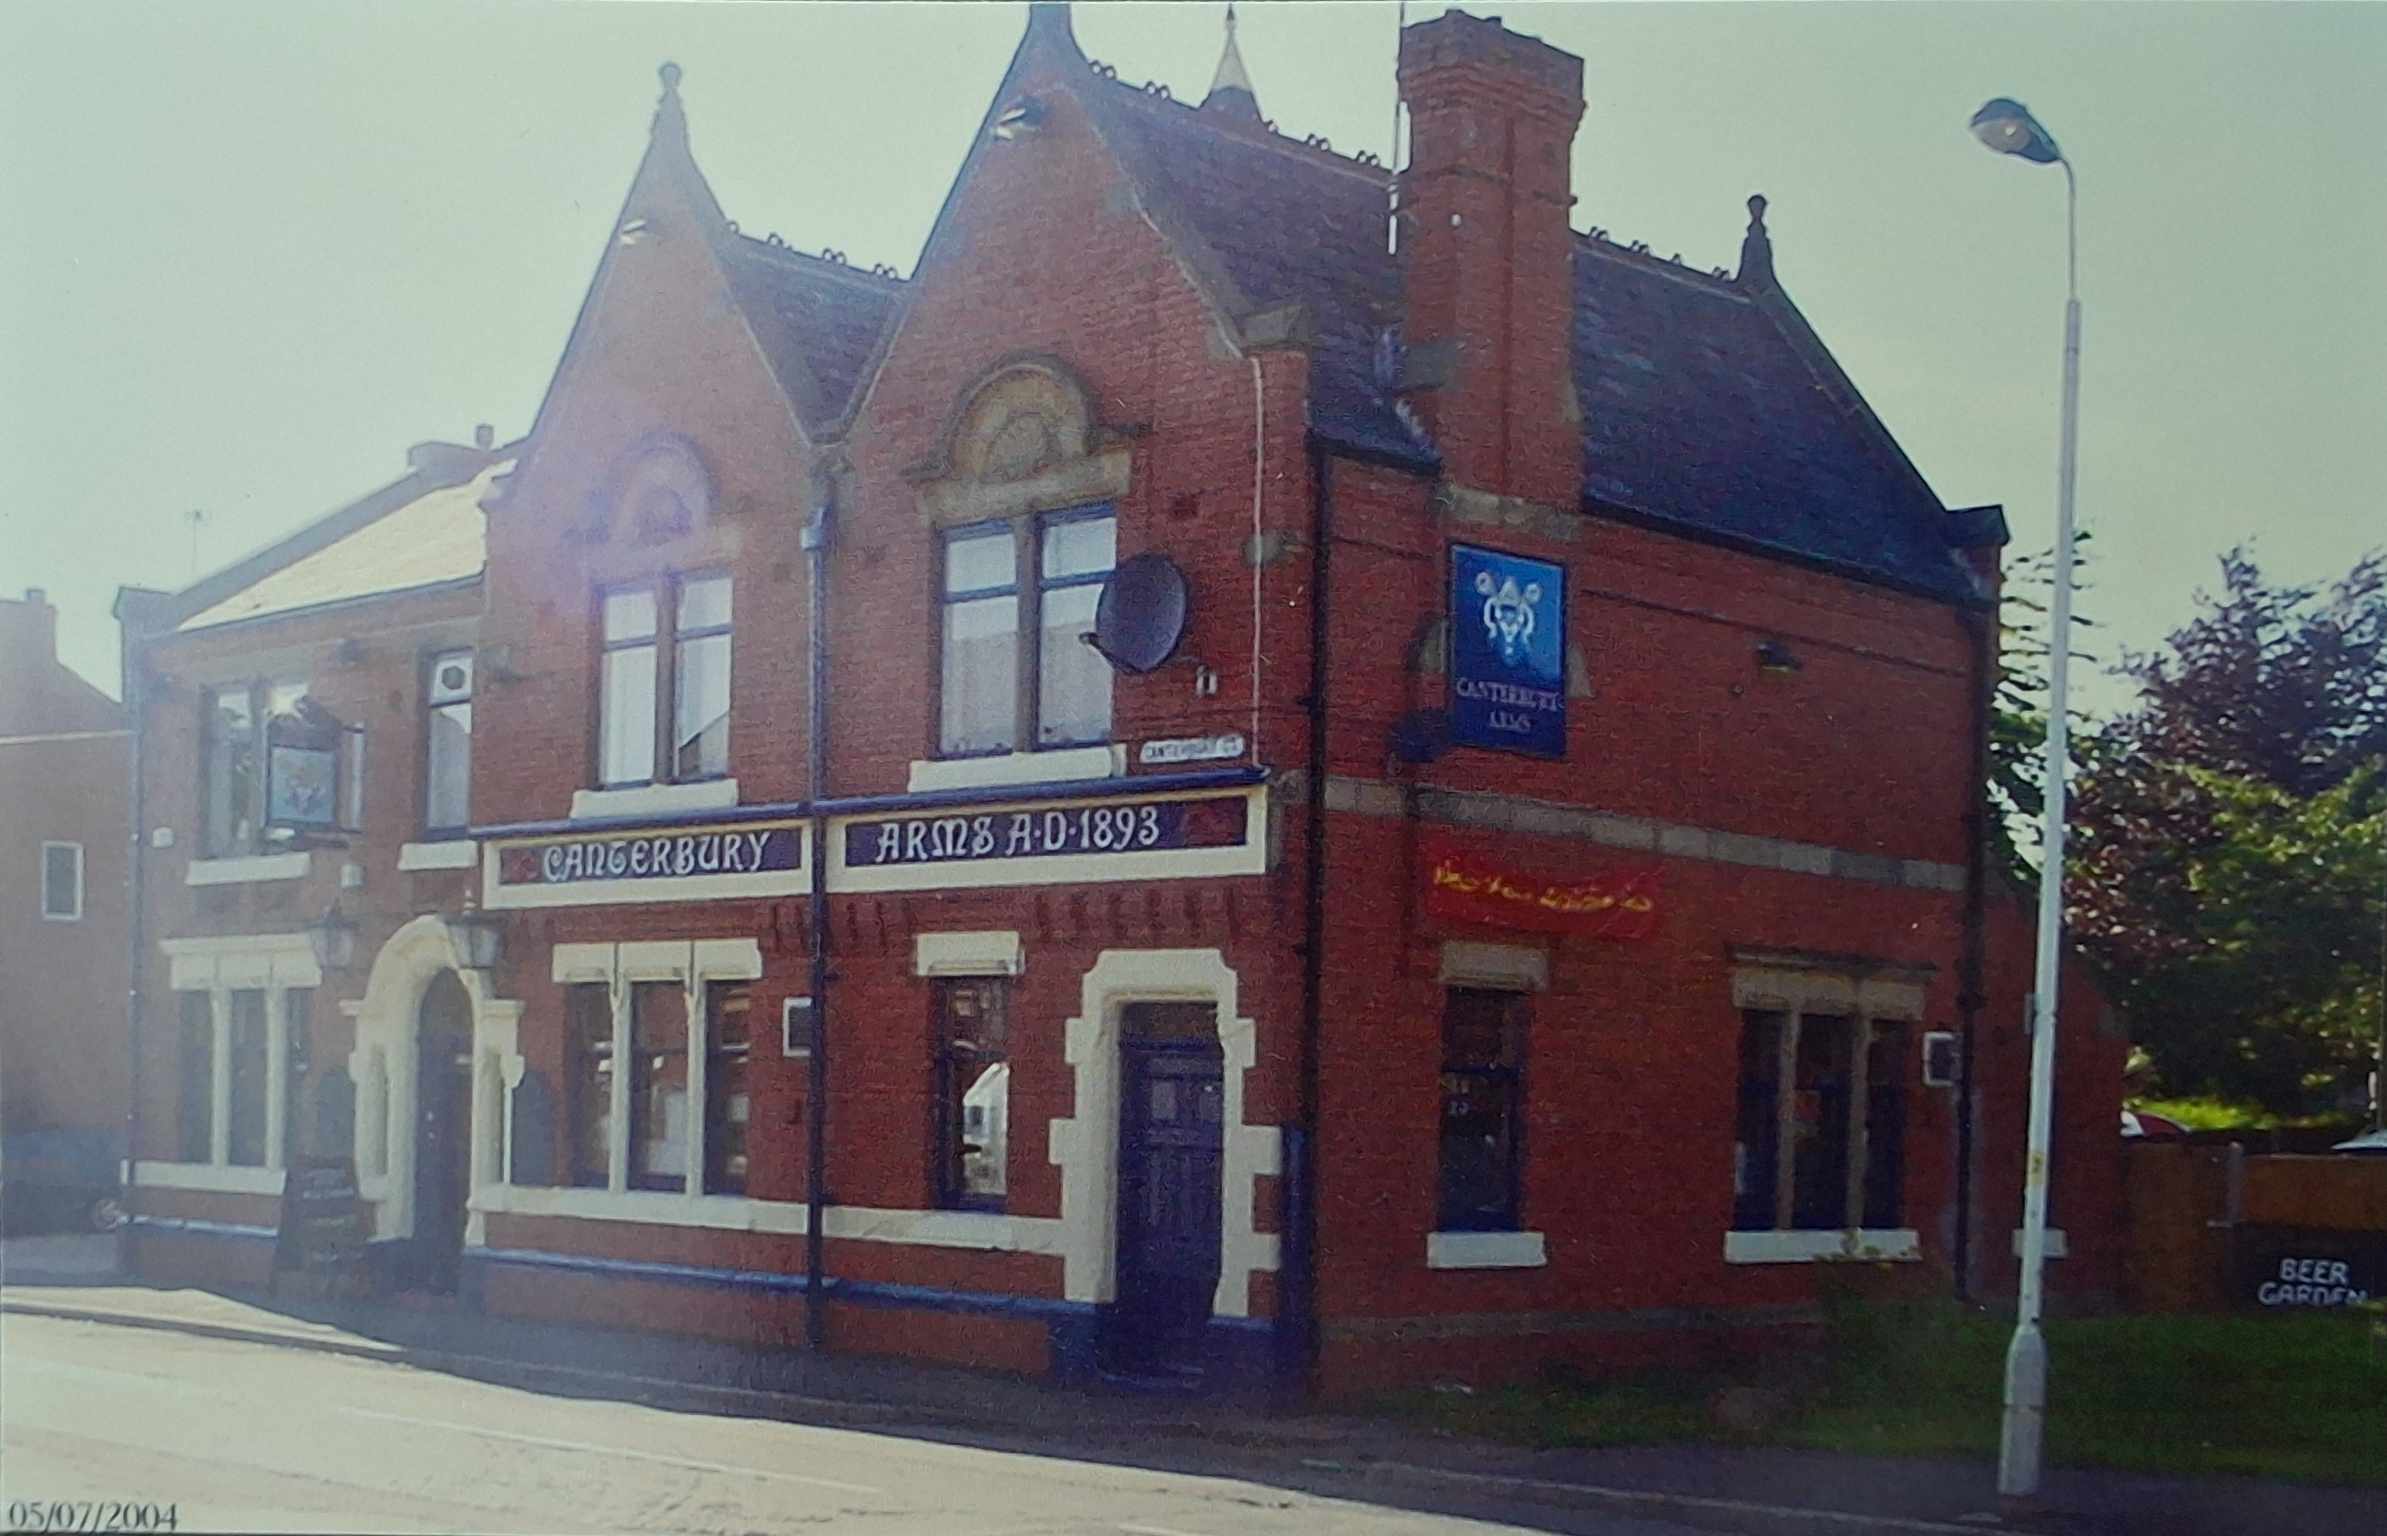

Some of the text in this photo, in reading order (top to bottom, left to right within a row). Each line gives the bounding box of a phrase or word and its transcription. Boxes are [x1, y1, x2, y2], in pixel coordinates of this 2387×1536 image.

[543, 831, 771, 882] CANTERBURY
[875, 815, 995, 863] ARMS
[2279, 1257, 2348, 1285] BEER
